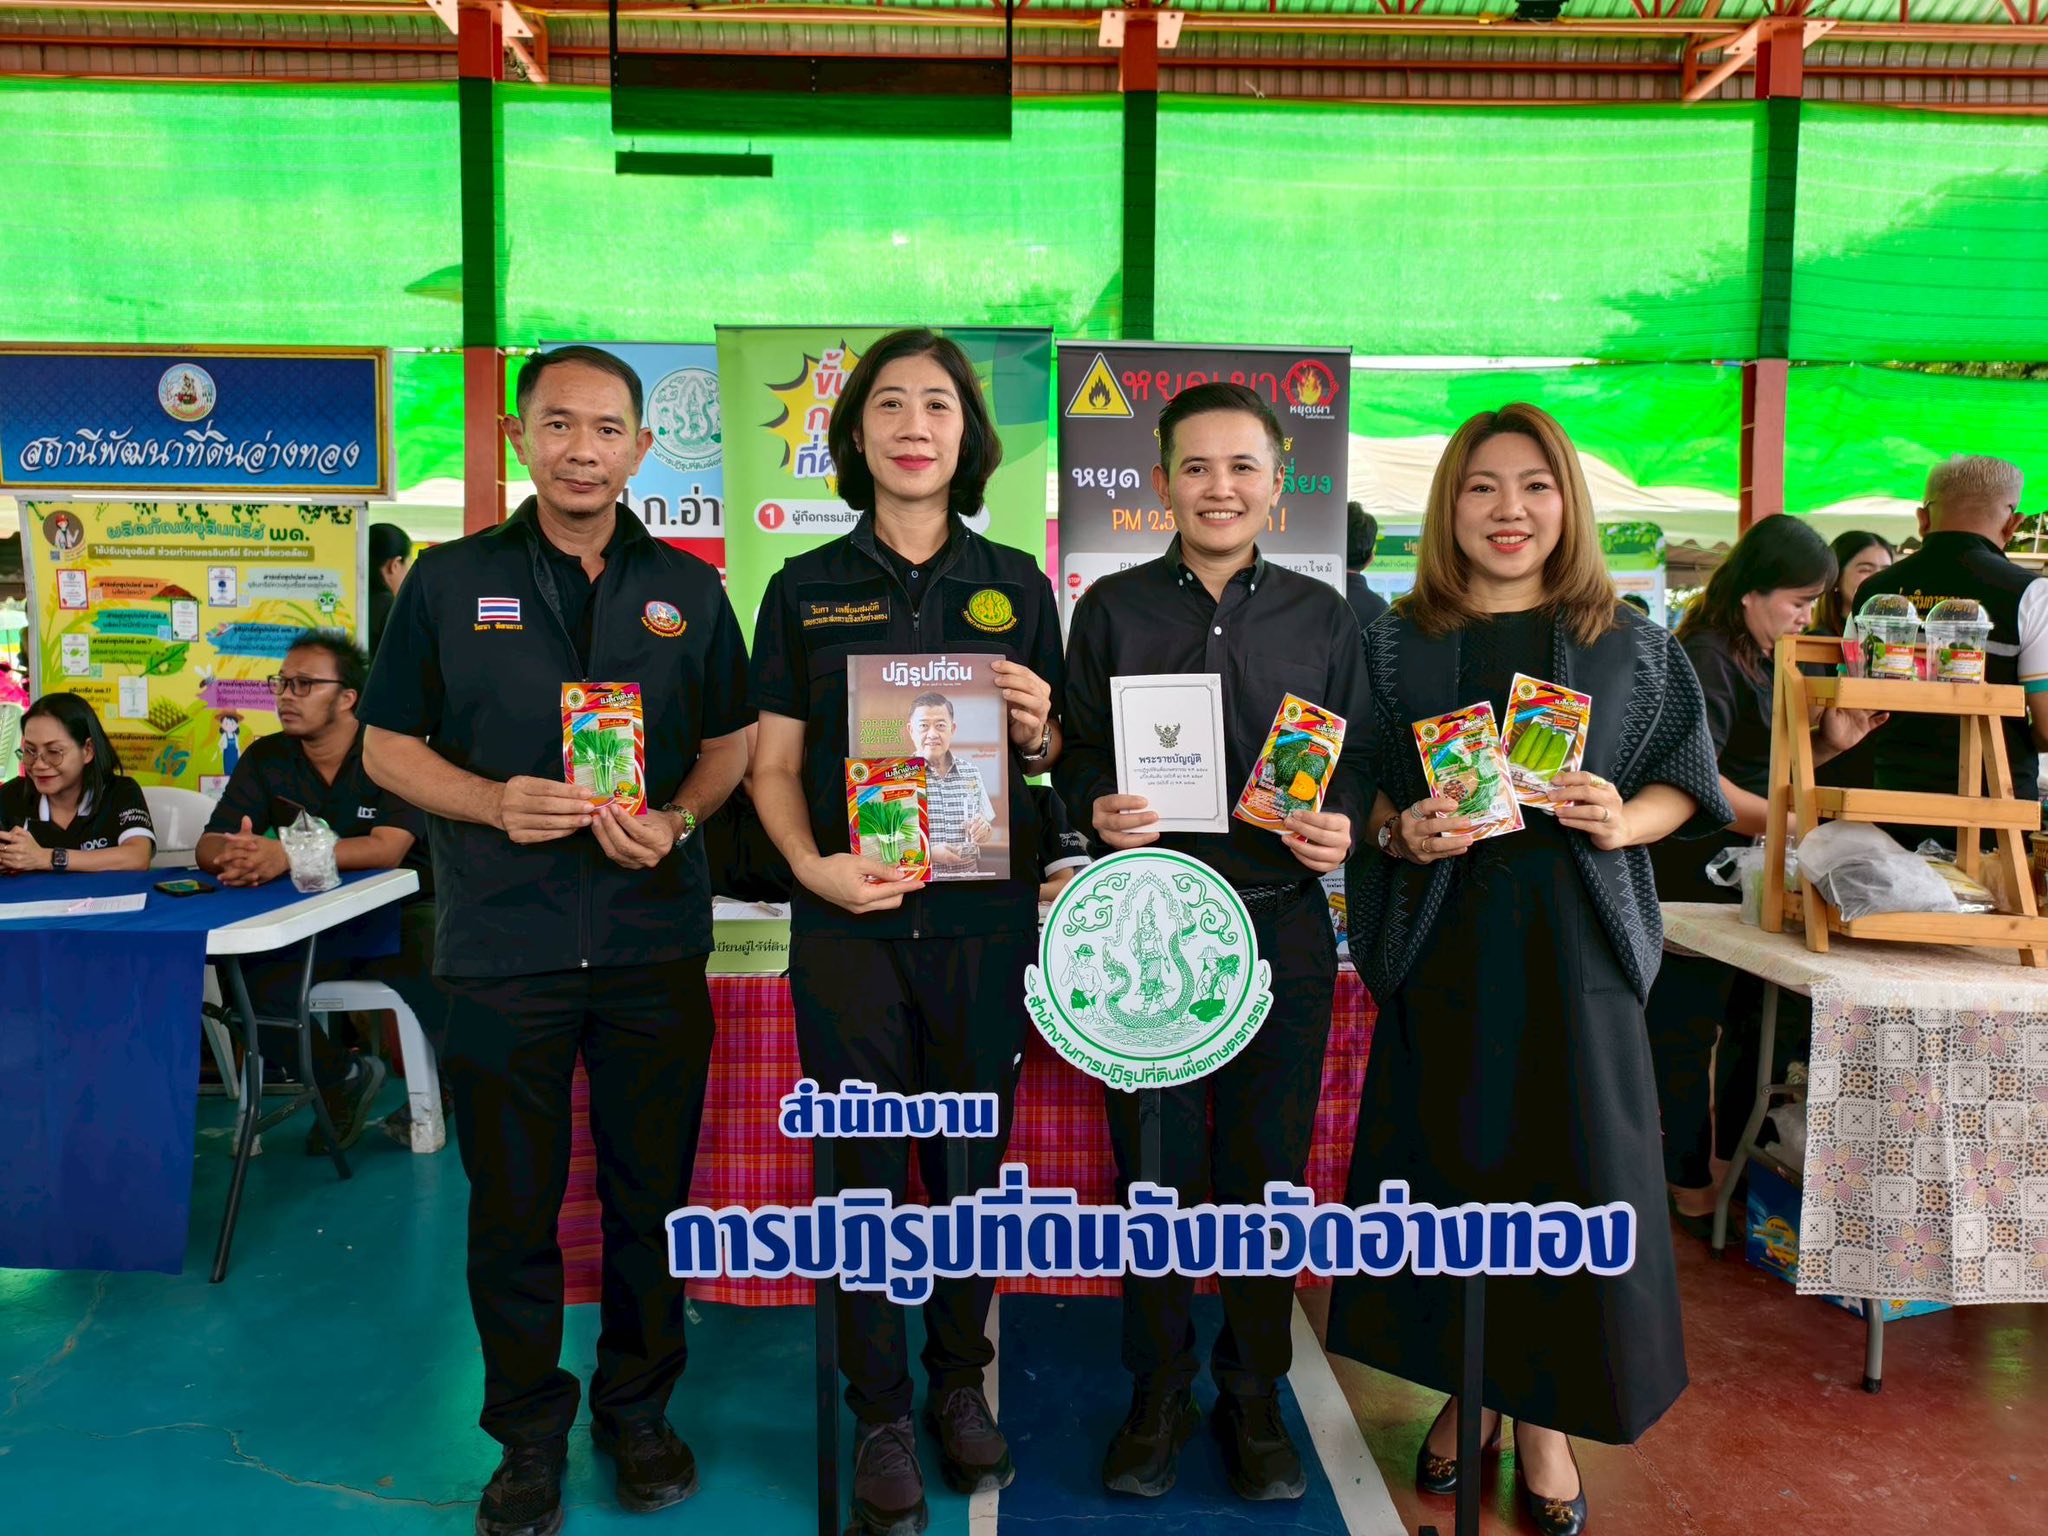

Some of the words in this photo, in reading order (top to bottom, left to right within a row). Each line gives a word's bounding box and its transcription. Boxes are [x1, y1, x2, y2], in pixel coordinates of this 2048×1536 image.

[1289, 405, 1331, 417] หยุดเผา
[20, 421, 361, 474] สถานีพัฒนาที่ดินอ่างทอง
[1072, 465, 1141, 499] หยุด
[1111, 509, 1142, 532] PM
[269, 527, 310, 542] พด.
[882, 656, 972, 688] ปฏิรูปที่ดิน
[859, 727, 899, 736] AWARDS
[1138, 753, 1202, 765] พระราชบัญญัติ
[717, 938, 788, 956] บียนผู้ไร้ที่ดิน
[1029, 992, 1271, 1088] สำนักงานการปฏิรูปที่ดินเพื่อเกษตรกรรม
[785, 1083, 994, 1134] สำนักงาน
[671, 1170, 1629, 1301] การปฏิรูปที่ดินจังหวัดอ่างทอง
